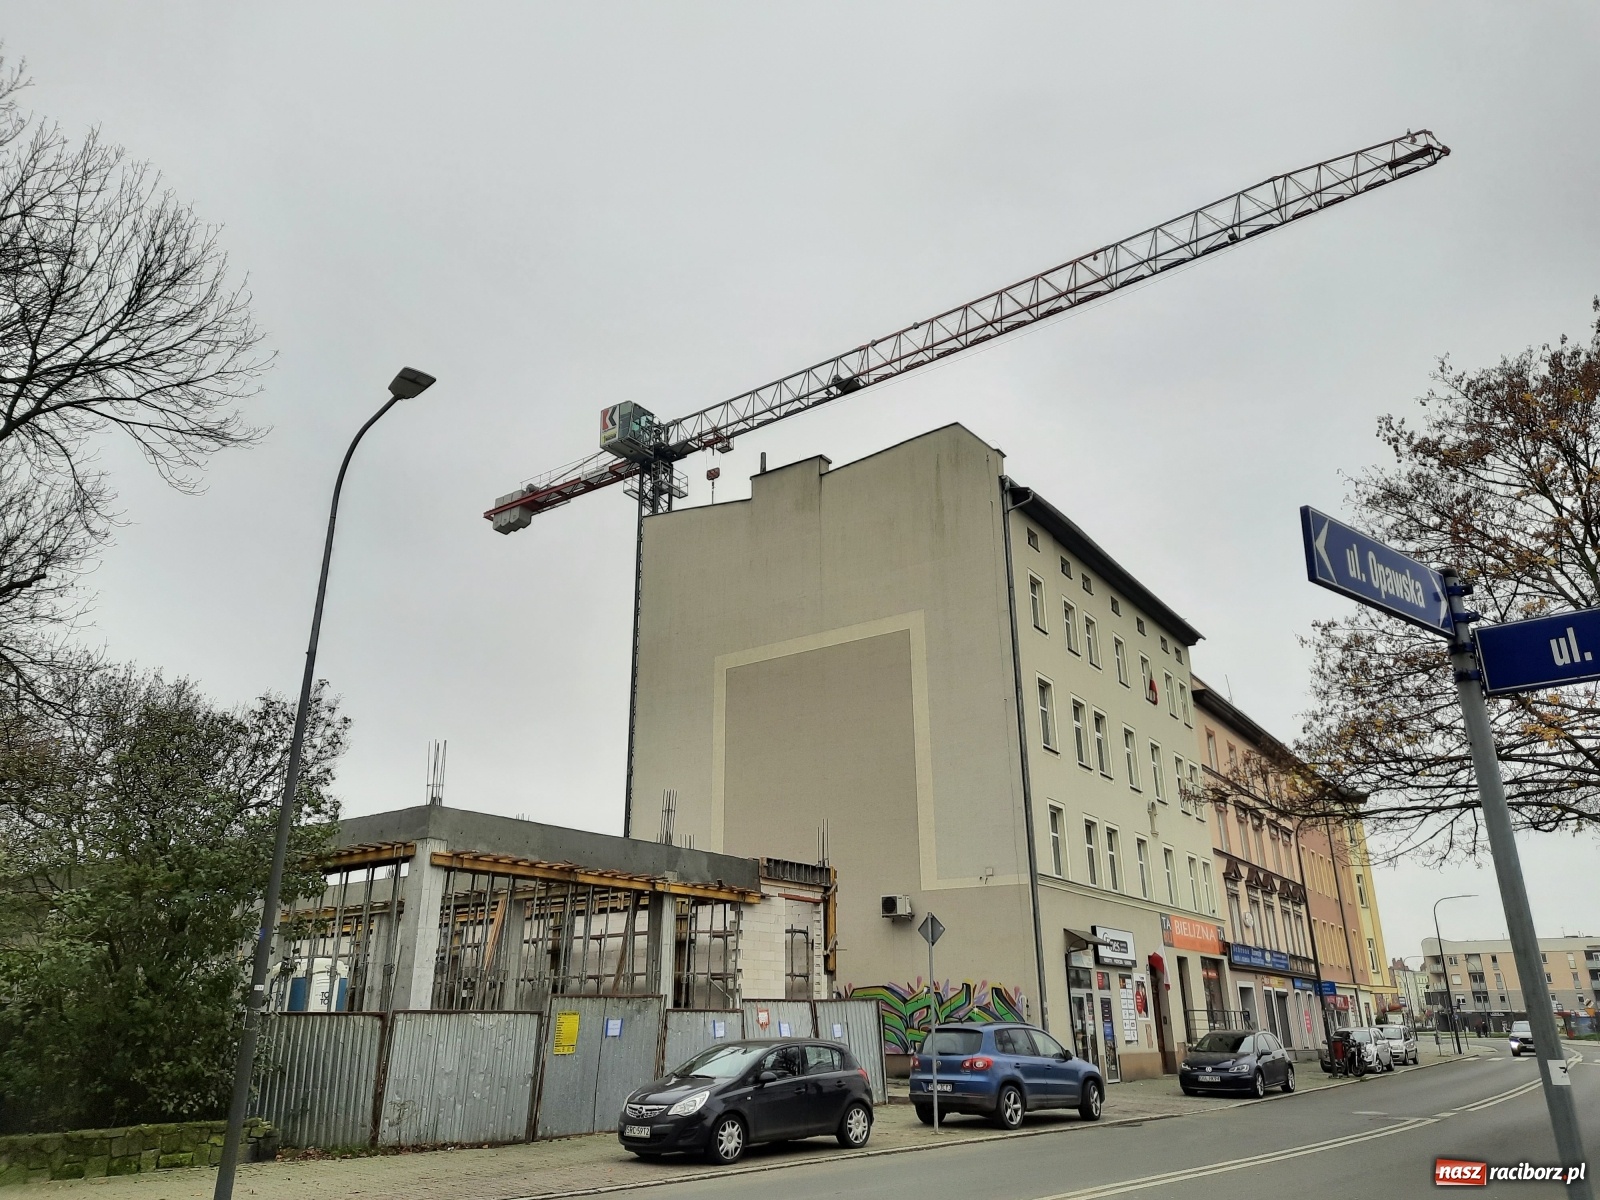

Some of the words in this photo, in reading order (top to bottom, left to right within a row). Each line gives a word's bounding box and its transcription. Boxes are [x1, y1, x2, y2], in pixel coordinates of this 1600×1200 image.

[1346, 543, 1366, 583] ul.
[1368, 550, 1426, 609] Opawska
[1549, 627, 1594, 667] ul.
[1174, 920, 1216, 942] BIELIZNA
